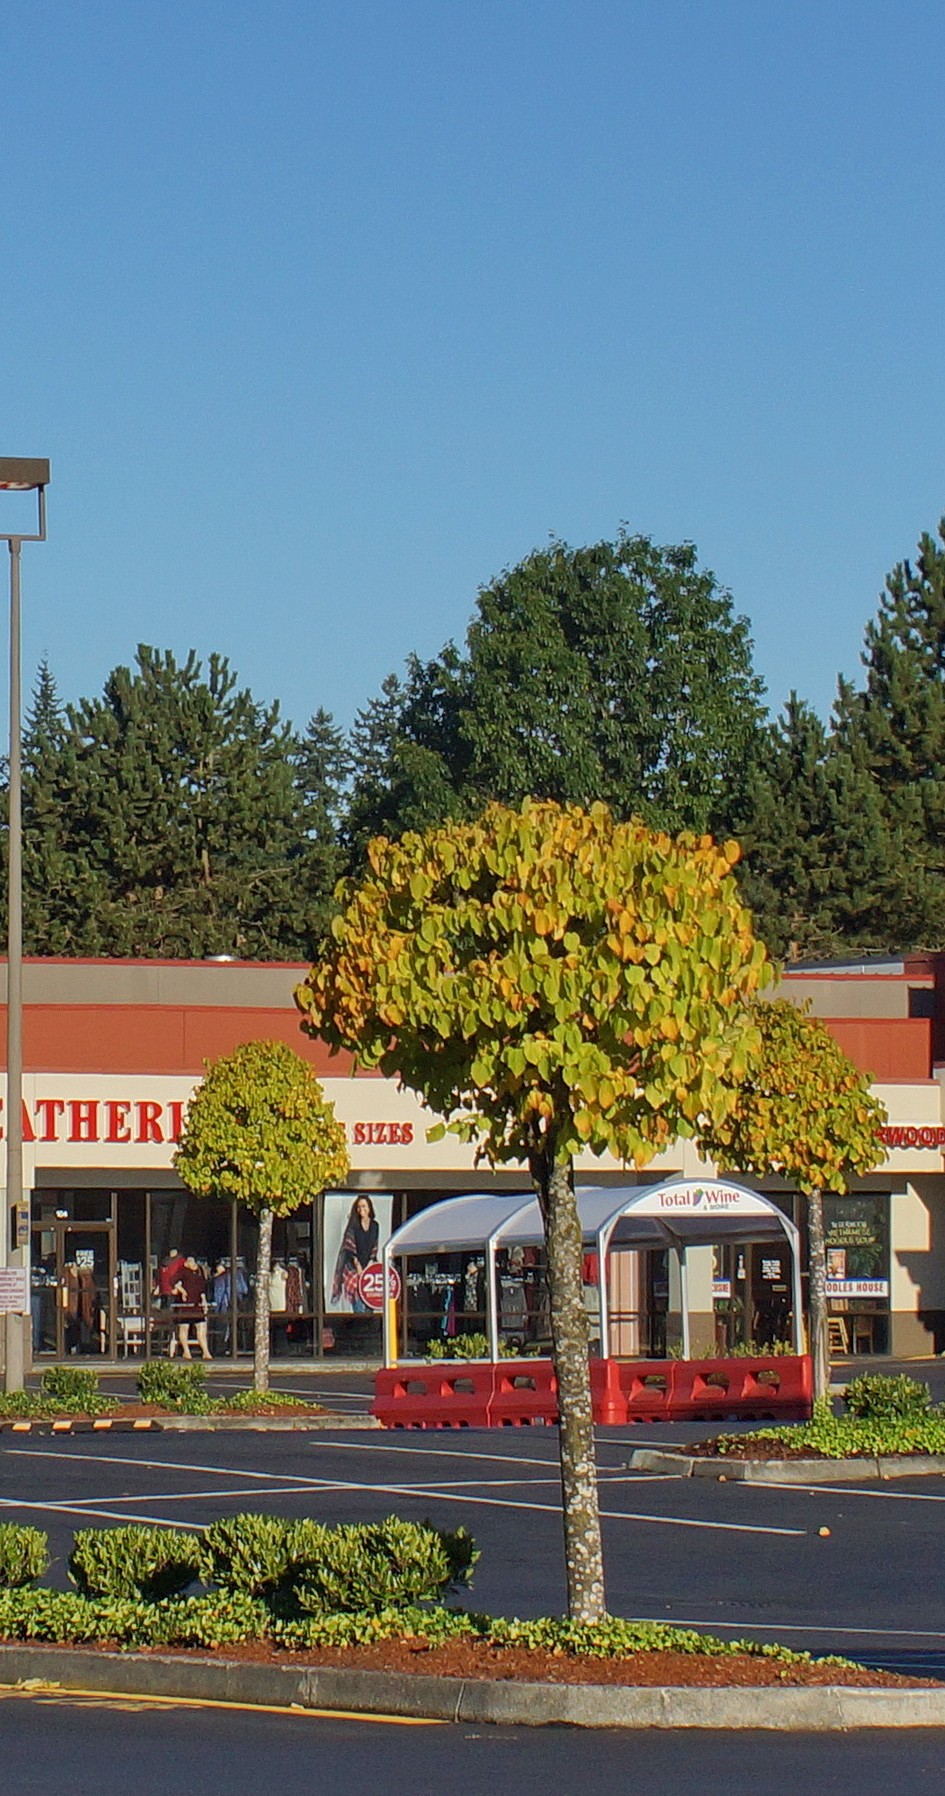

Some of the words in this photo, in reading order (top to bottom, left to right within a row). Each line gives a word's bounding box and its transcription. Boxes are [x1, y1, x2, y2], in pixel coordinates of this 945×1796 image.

[0, 1098, 184, 1143] ATHERI
[353, 1122, 413, 1144] SIZES
[658, 1190, 690, 1207] Total
[705, 1189, 740, 1204] Wine
[826, 1282, 853, 1292] ODLES
[857, 1282, 884, 1292] HOUSE
